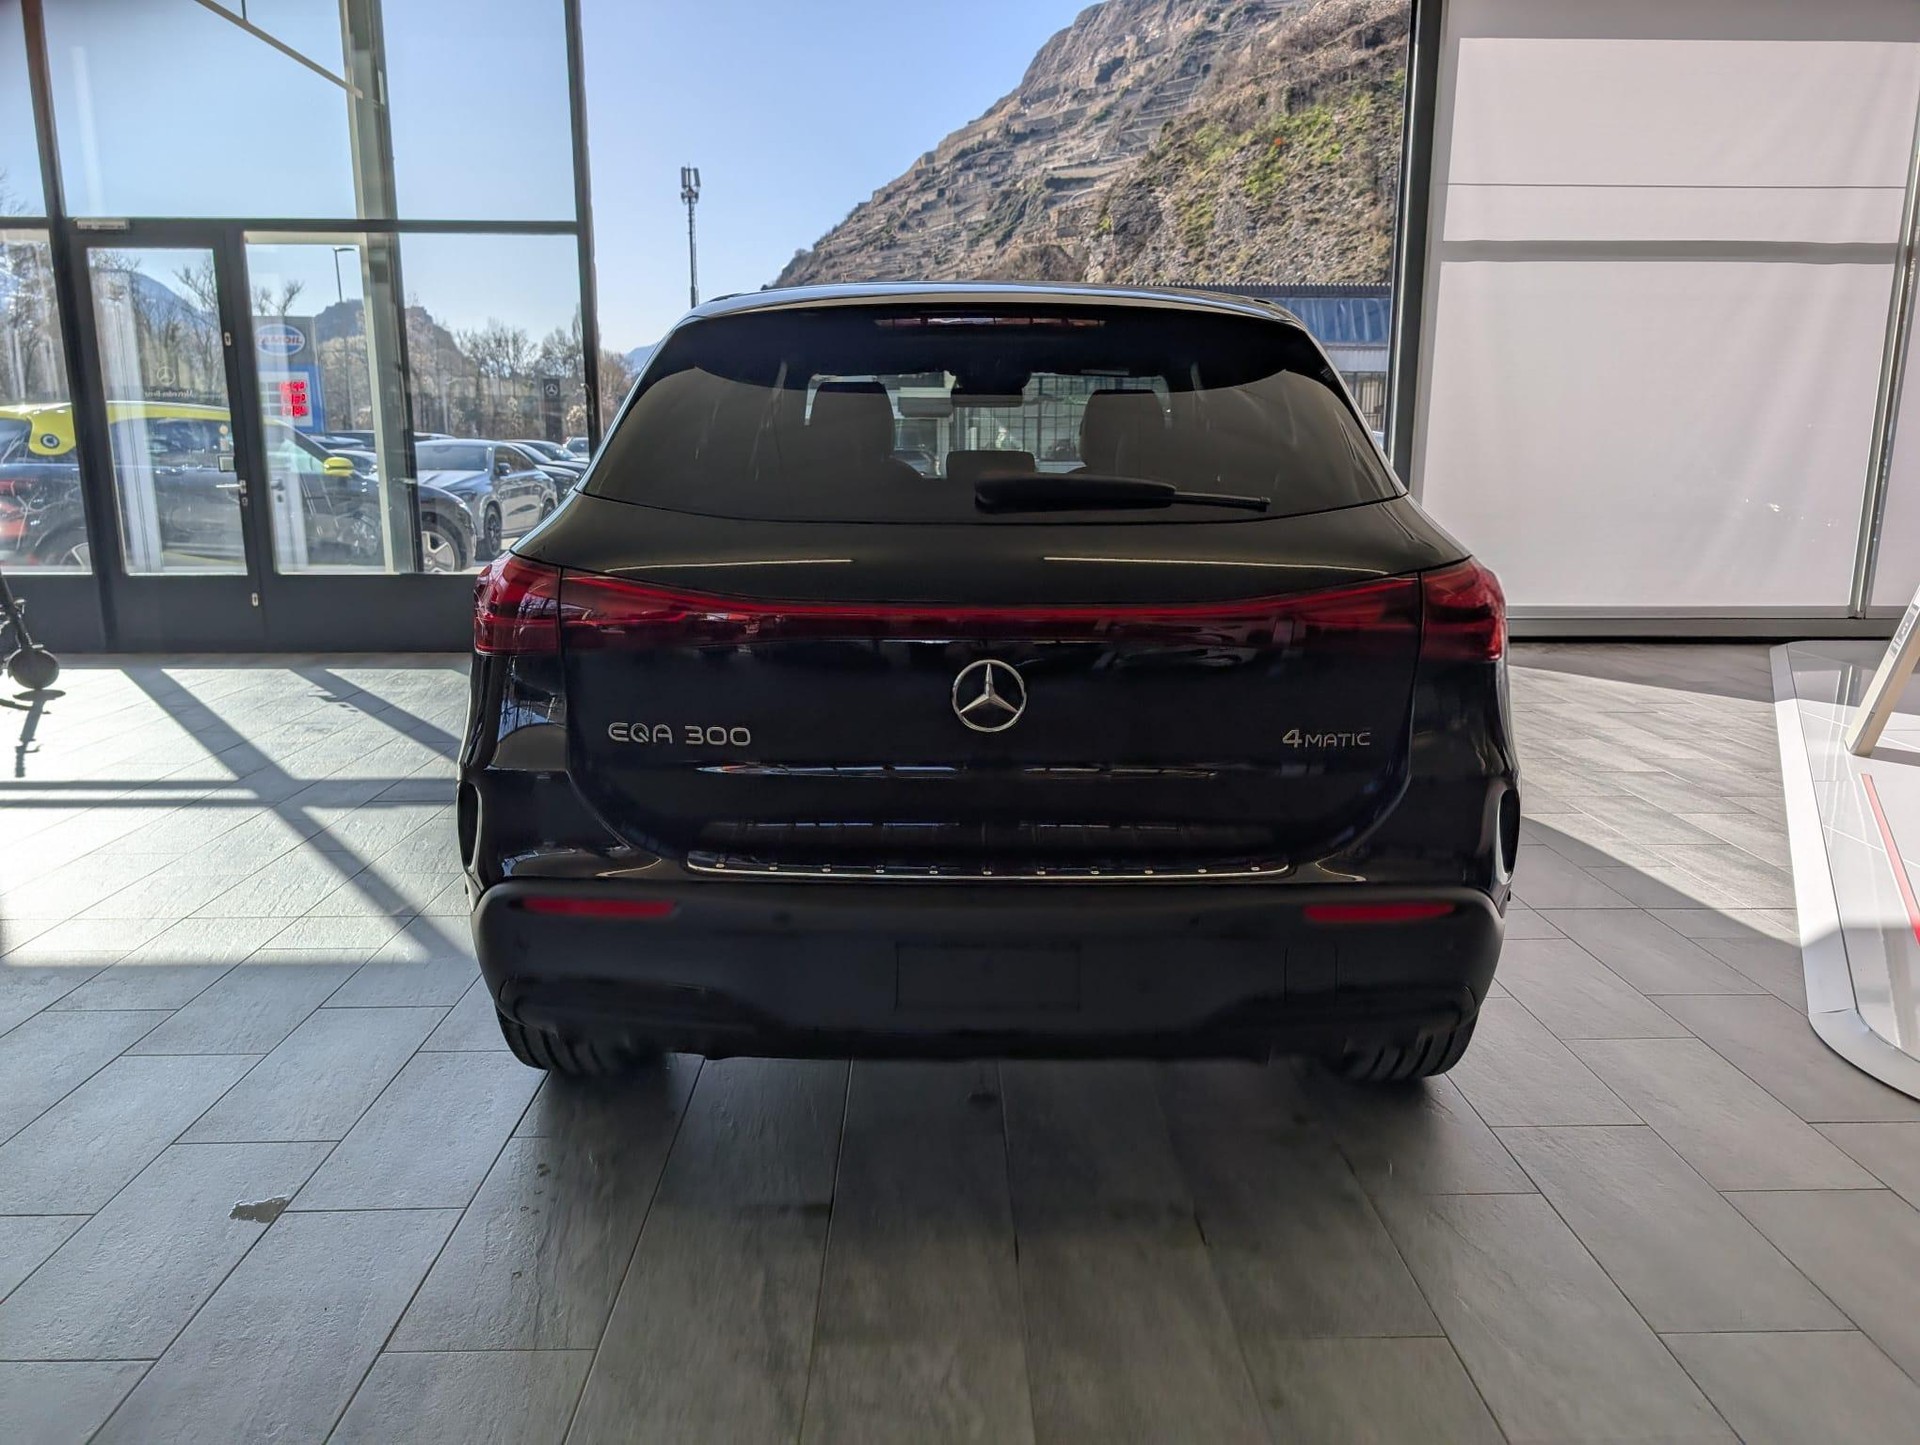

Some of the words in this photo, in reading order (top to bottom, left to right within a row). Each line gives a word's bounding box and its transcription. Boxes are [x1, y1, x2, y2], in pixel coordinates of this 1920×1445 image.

[608, 722, 673, 744] EQA
[684, 725, 751, 746] 300
[1282, 729, 1371, 748] 4MATIC
